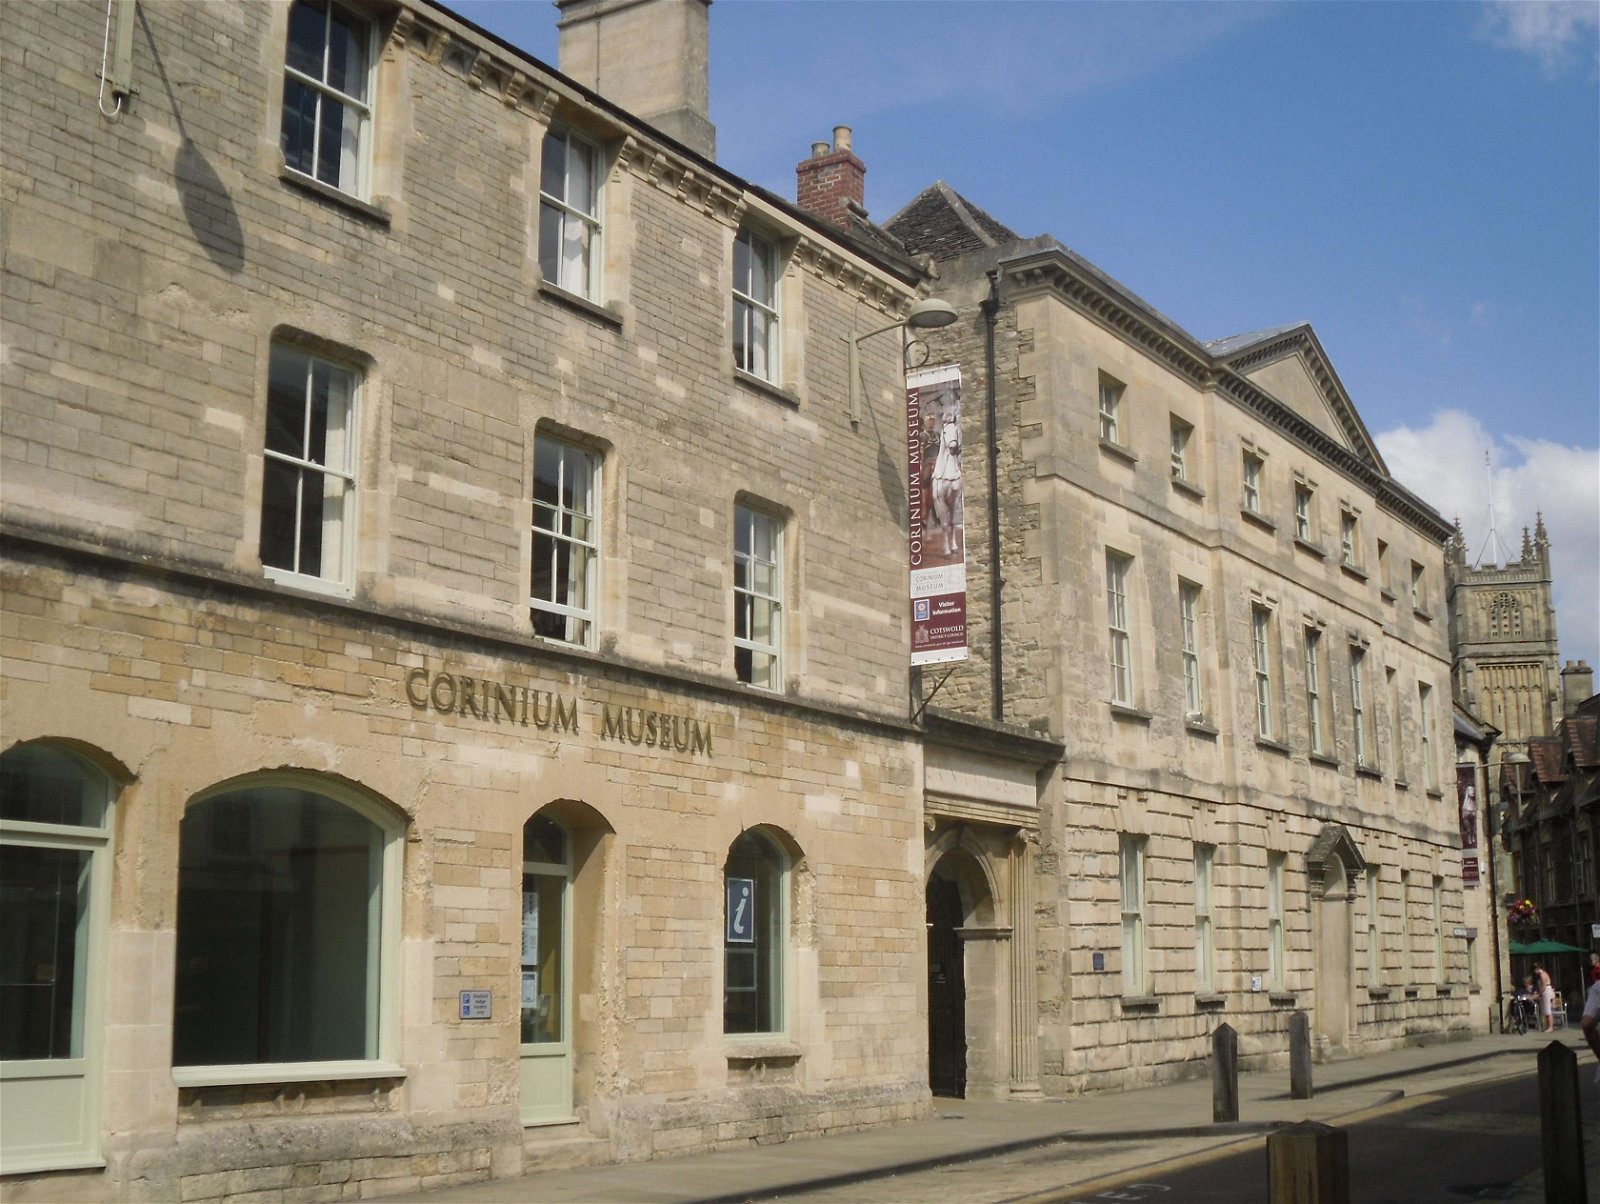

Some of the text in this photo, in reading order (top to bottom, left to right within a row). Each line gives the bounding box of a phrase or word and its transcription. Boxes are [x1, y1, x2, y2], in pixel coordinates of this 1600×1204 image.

[908, 392, 922, 566] CORINIUM MUSEUM
[916, 574, 944, 582] CORINIUM
[916, 583, 944, 591] MUSEUM
[930, 625, 964, 634] COTSWOLD
[405, 667, 714, 759] CORINIUM MUSEUM
